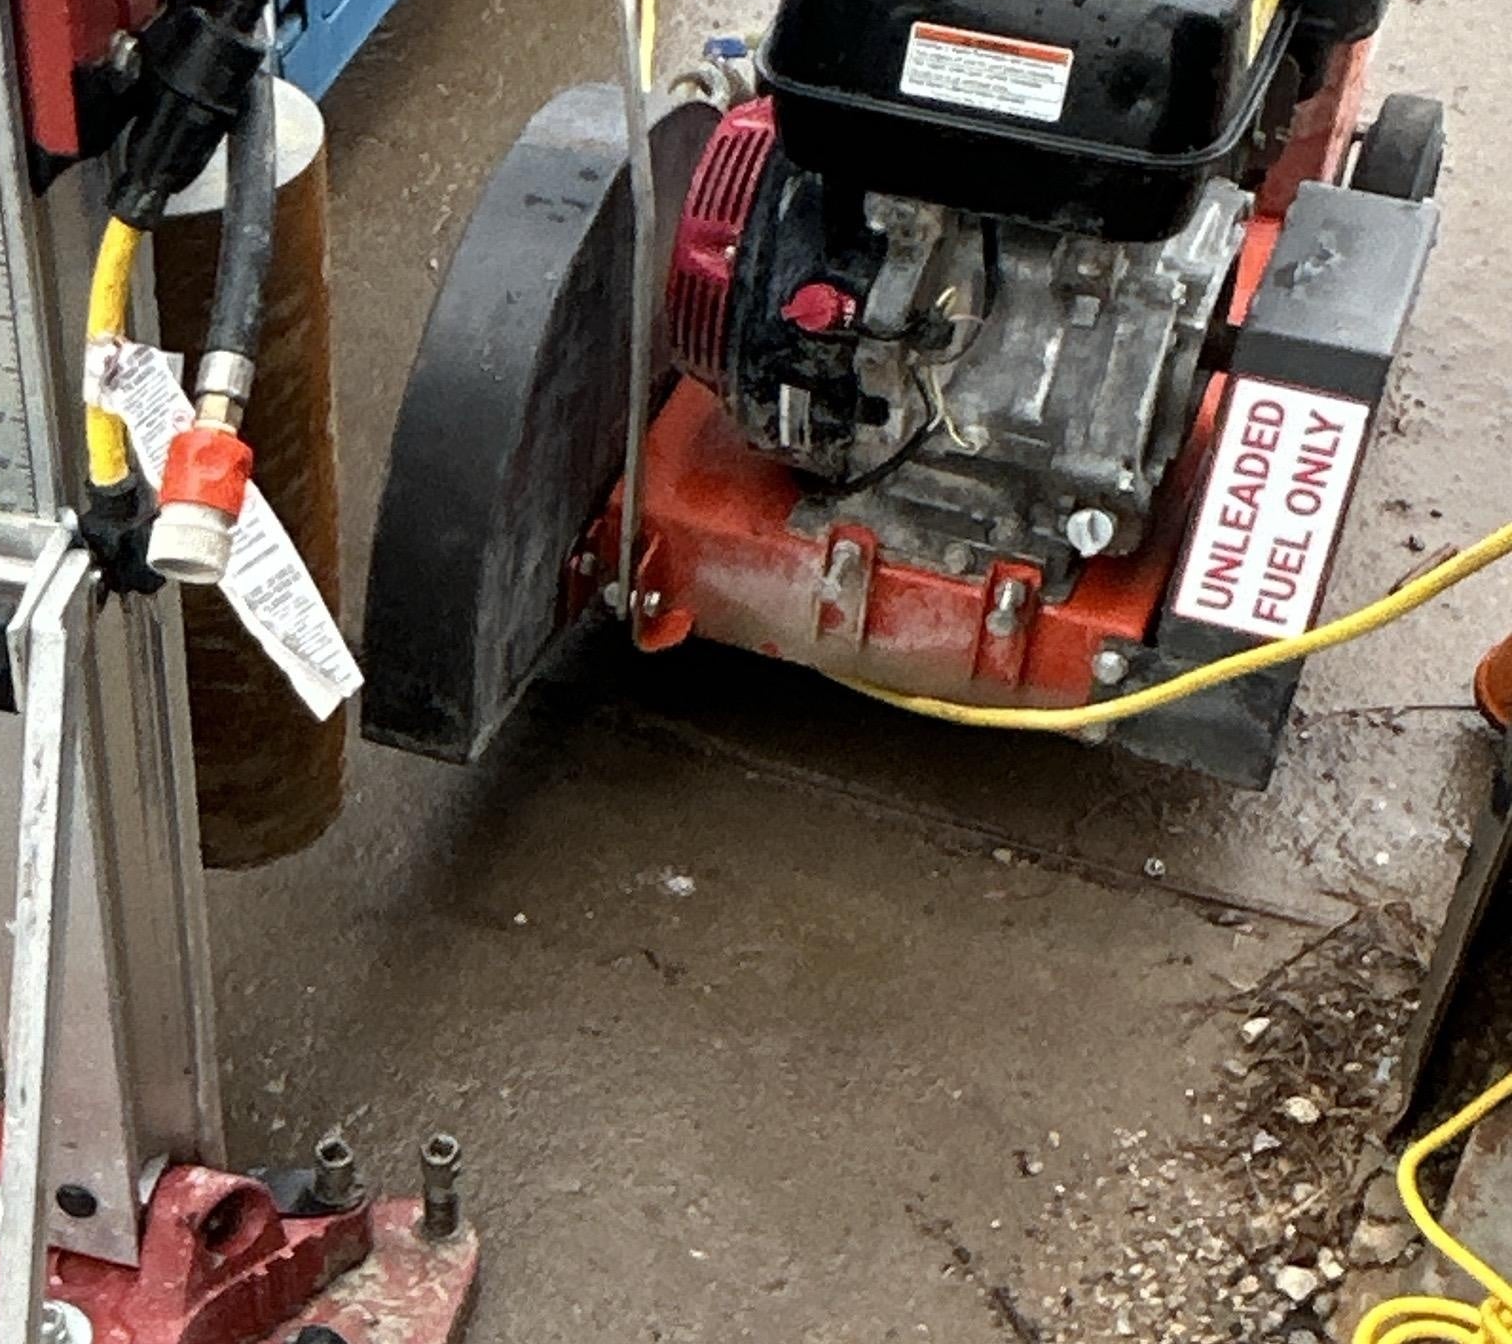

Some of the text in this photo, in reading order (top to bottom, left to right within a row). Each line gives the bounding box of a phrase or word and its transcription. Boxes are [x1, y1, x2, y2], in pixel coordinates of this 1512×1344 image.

[1196, 399, 1285, 611] UNLEADED
[1251, 408, 1345, 625] FUEL ONLY
